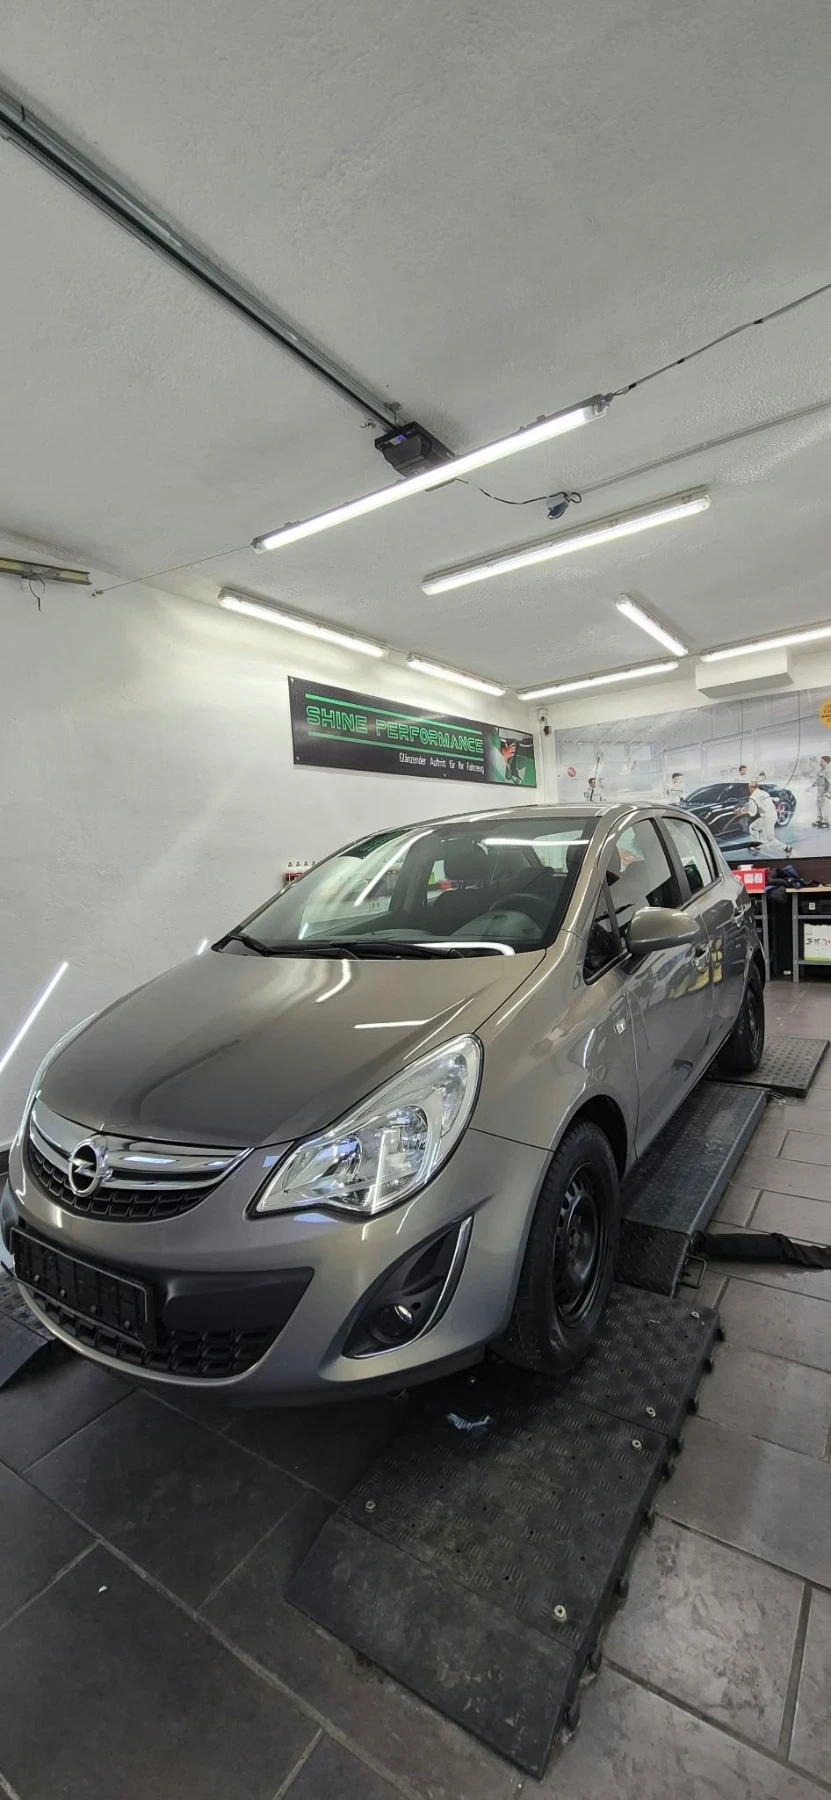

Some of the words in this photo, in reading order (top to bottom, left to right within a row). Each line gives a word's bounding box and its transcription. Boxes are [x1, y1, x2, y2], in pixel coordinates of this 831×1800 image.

[306, 706, 367, 734] SHINE
[376, 720, 483, 753] PERFORMANCE
[399, 752, 426, 766] Glänzender
[467, 762, 485, 774] Fahrzeug
